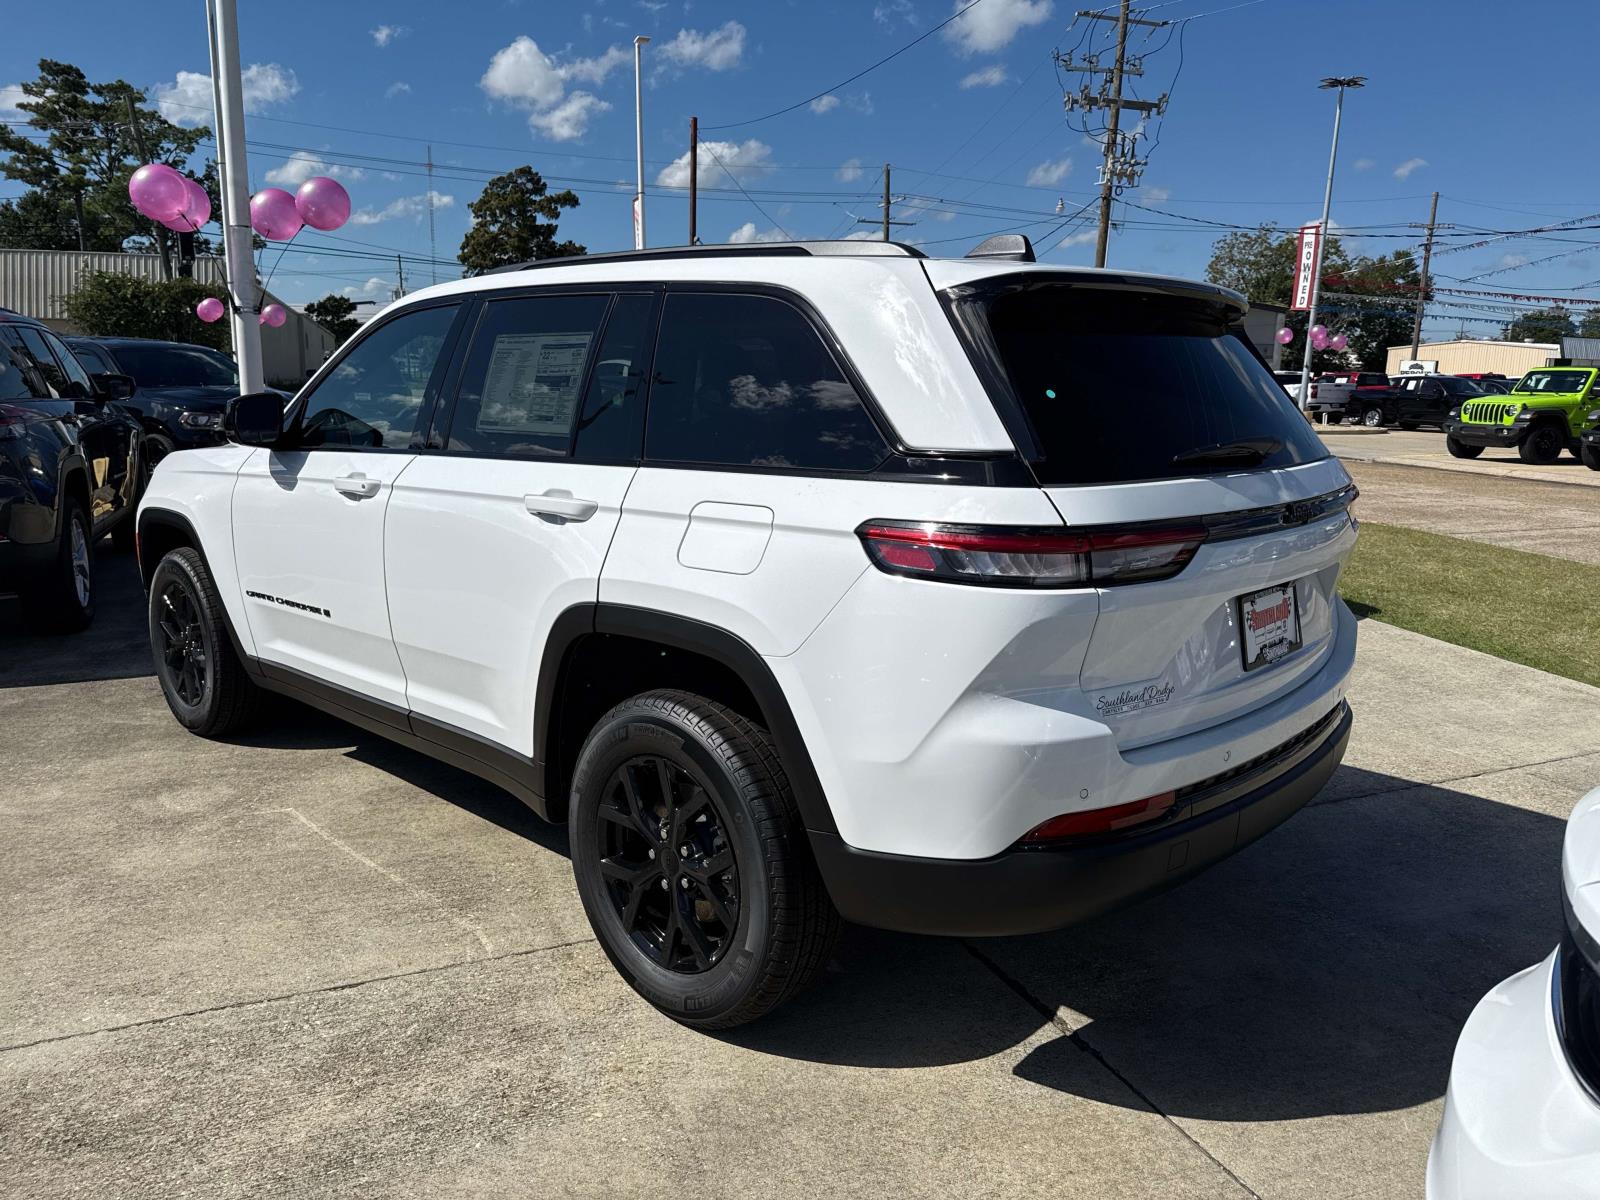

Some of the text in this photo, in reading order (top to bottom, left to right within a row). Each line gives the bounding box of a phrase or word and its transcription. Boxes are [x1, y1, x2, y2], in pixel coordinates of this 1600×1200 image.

[1304, 241, 1313, 249] PRE
[1299, 251, 1312, 305] OWNED
[246, 590, 322, 615] GRAND CHEROKEE
[1096, 682, 1175, 710] Southland Dodge
